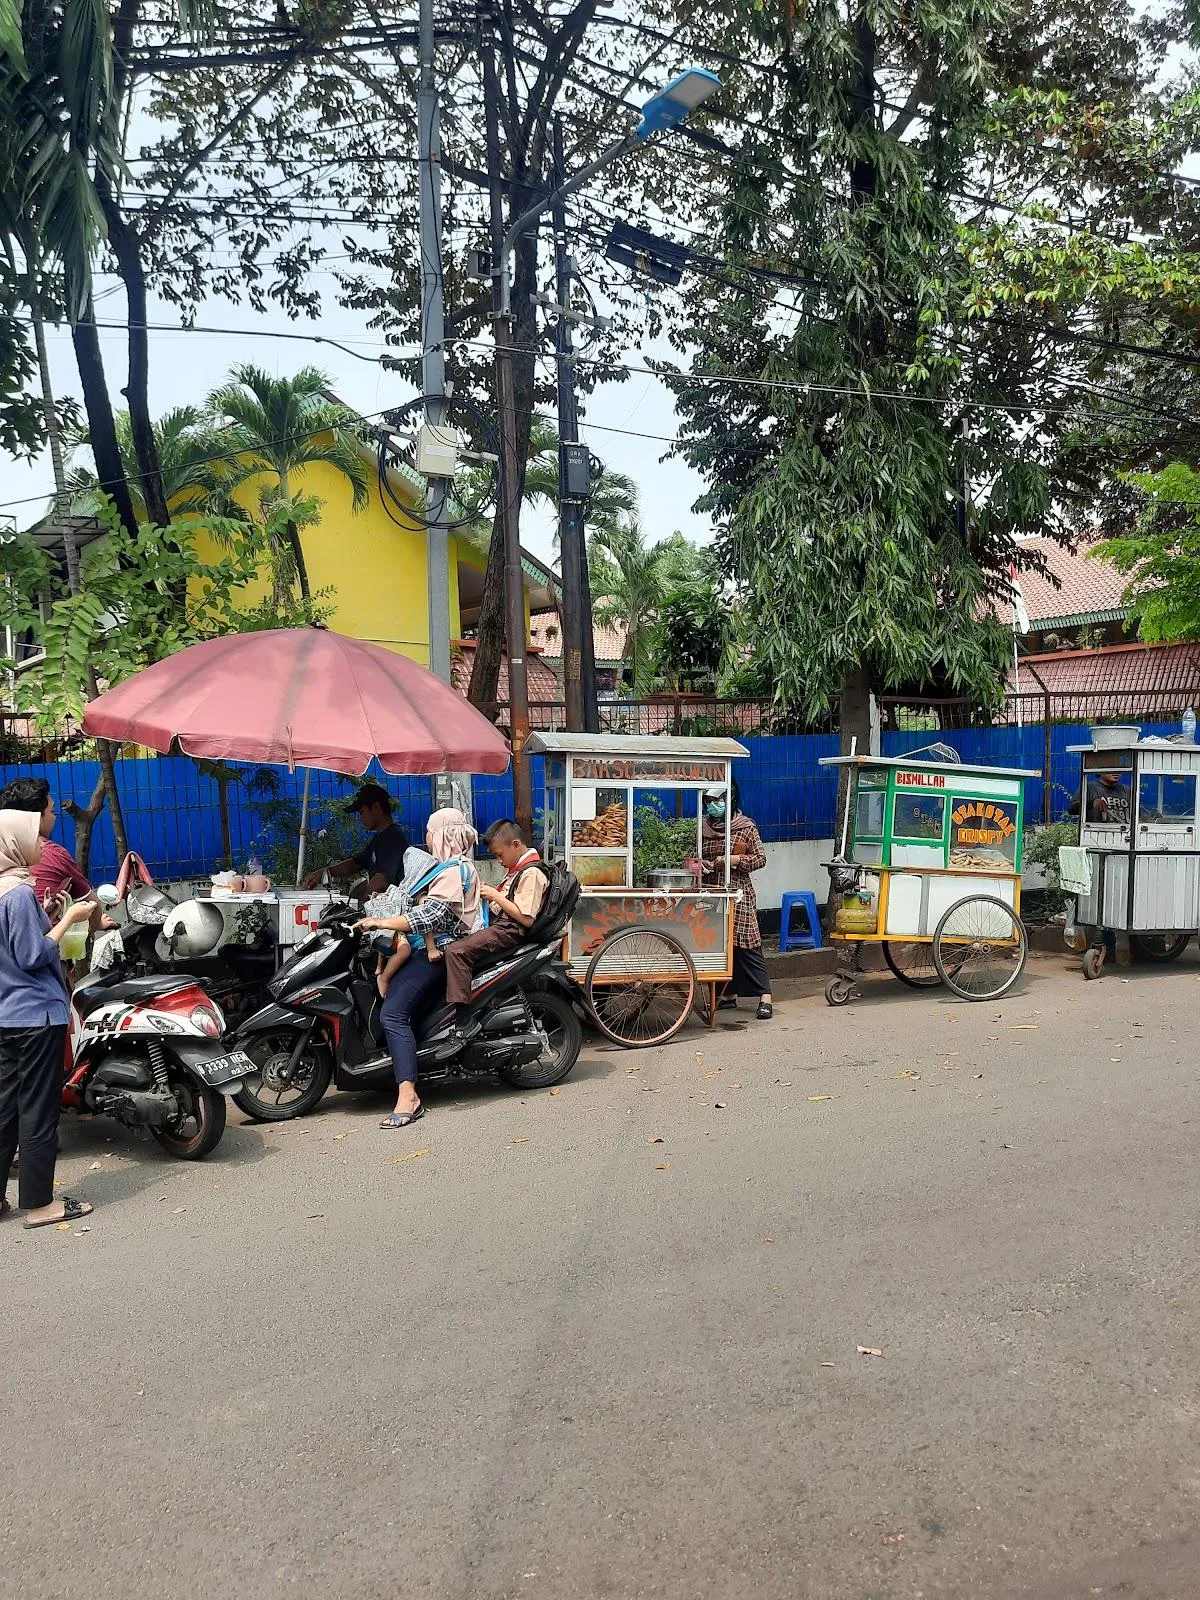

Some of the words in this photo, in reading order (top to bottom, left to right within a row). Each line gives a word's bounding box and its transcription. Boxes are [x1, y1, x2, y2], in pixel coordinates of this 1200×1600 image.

[896, 772, 946, 788] BISMILLAH
[957, 828, 1004, 845] CRISPY
[197, 1064, 206, 1075] B
